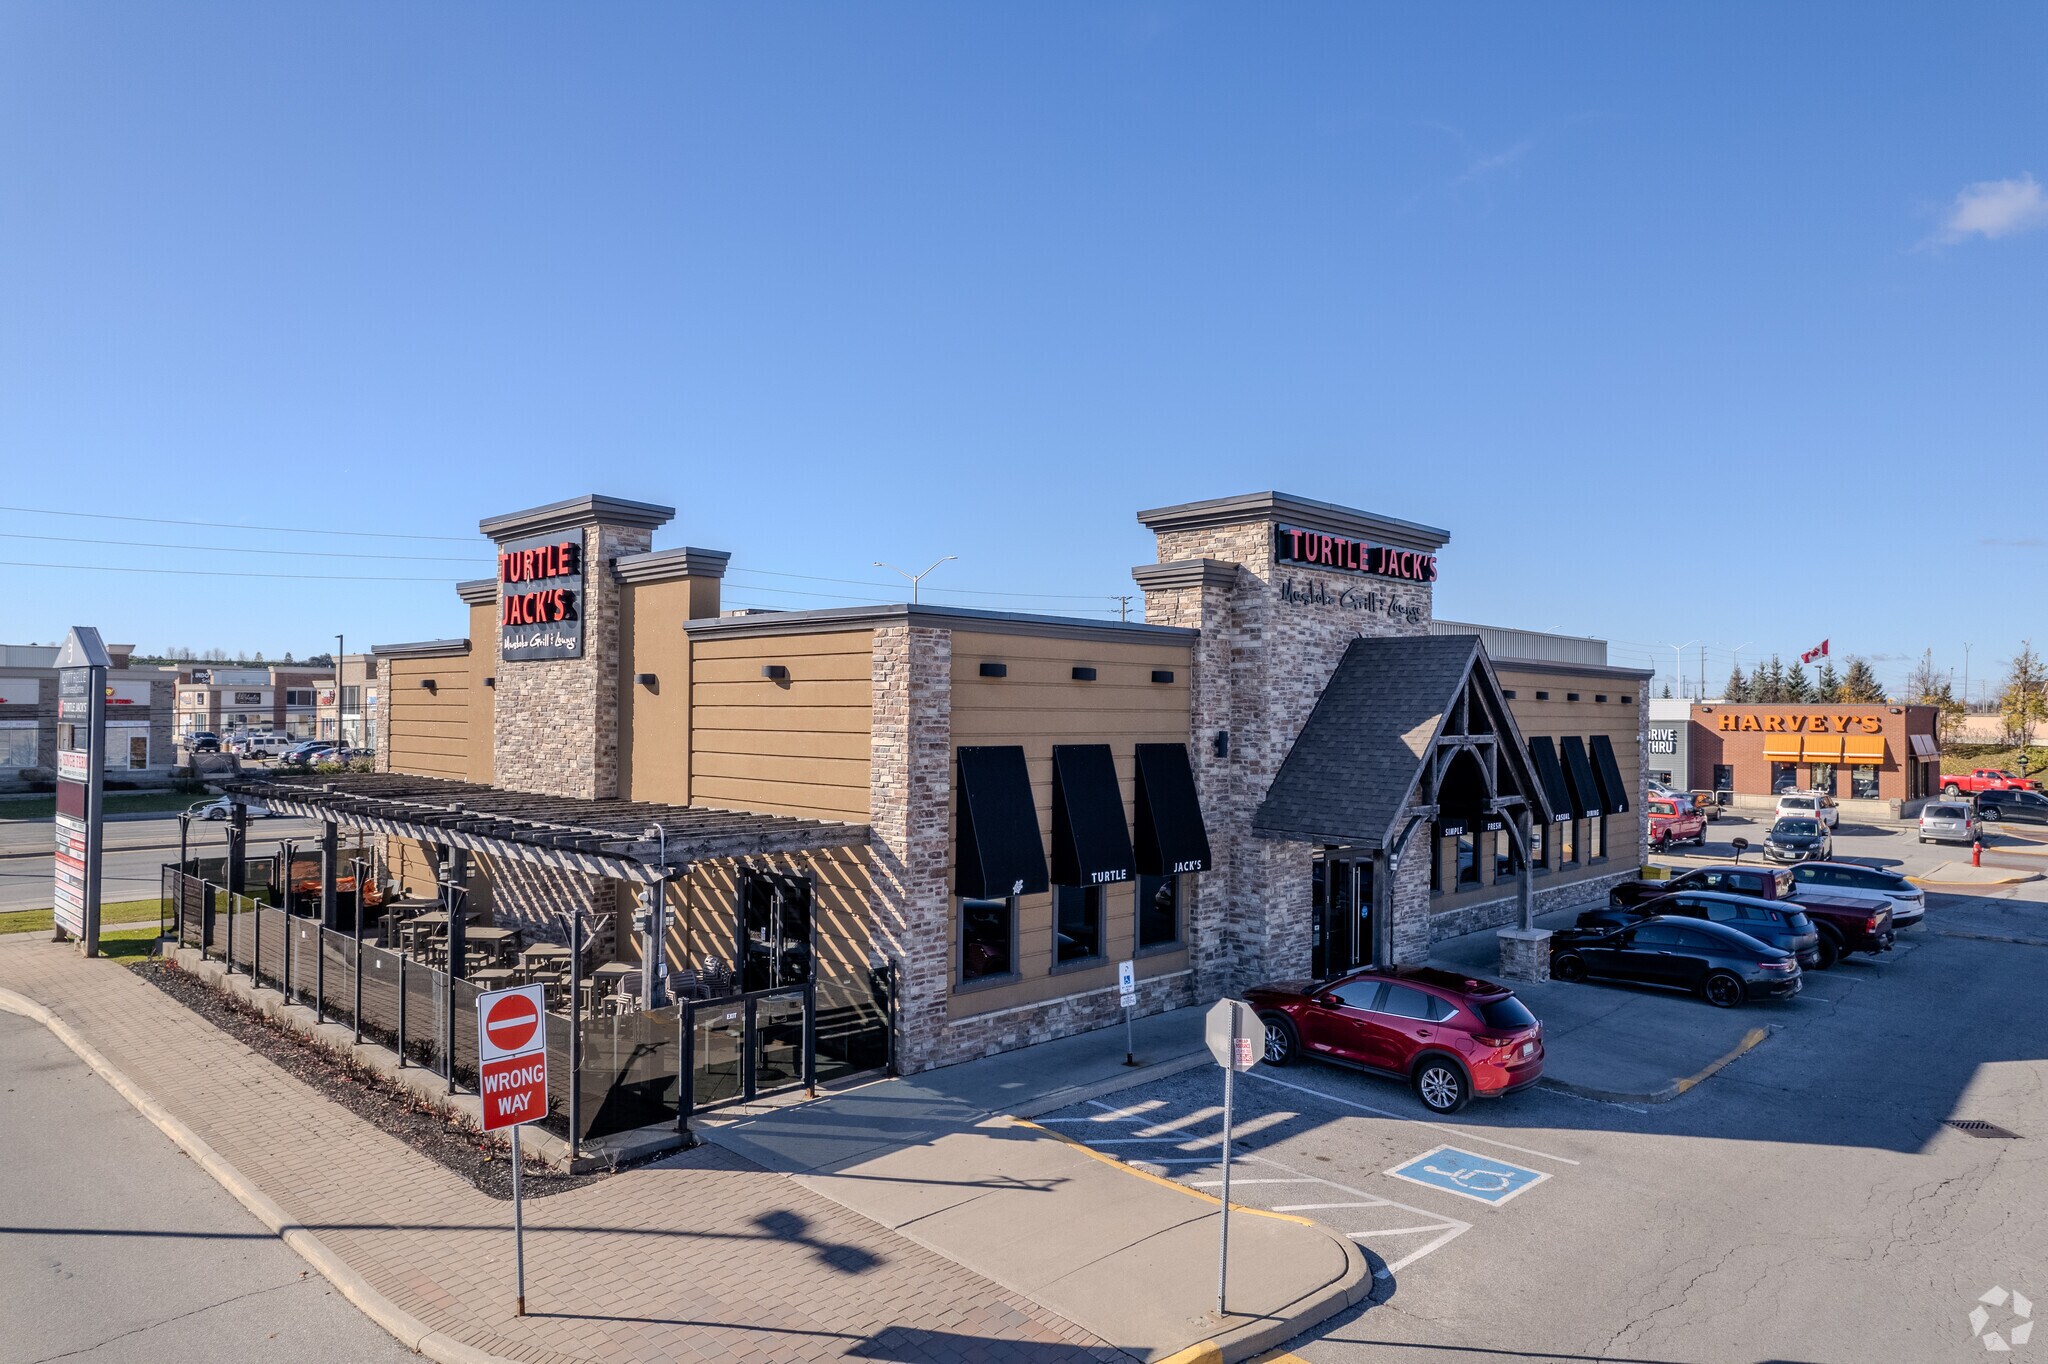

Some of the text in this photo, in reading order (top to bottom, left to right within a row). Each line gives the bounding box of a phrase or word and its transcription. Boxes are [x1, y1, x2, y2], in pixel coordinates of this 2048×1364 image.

[498, 542, 569, 583] TURTLE
[1290, 529, 1438, 582] TURTLE JACK'S
[502, 588, 565, 626] JACK'S
[1340, 586, 1376, 612] Grill
[1387, 594, 1421, 624] Lounge
[530, 633, 549, 647] Grill
[554, 632, 576, 650] Lounge
[1718, 714, 1880, 733] HARVEY'S
[1555, 809, 1599, 822] CASUAL DINING
[1445, 822, 1502, 836] SIMPLE FRESH
[1091, 859, 1202, 883] TURTLE JACK'S
[484, 1064, 544, 1095] WRONG
[498, 1091, 532, 1117] WAY
